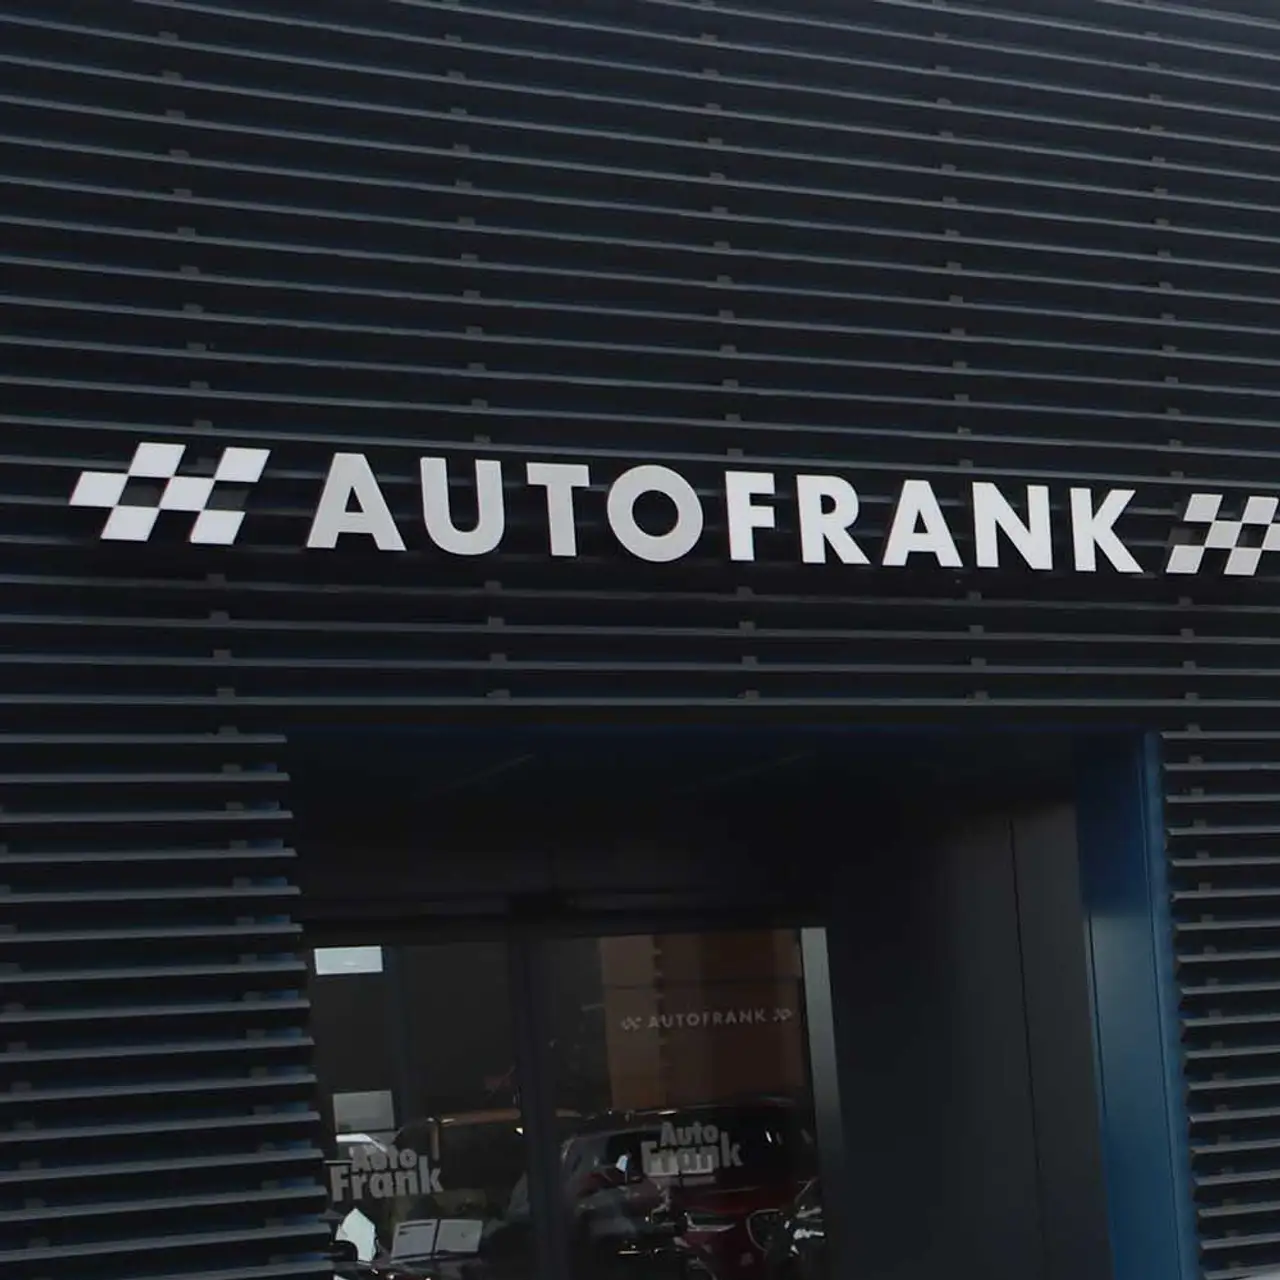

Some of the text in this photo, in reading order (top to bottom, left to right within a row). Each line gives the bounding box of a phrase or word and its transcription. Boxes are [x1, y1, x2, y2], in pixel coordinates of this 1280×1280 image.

[305, 452, 1144, 574] AUTOFRANK
[647, 1007, 767, 1029] AUTOFRANK
[660, 1120, 719, 1146] Auto
[329, 1155, 445, 1202] Frank
